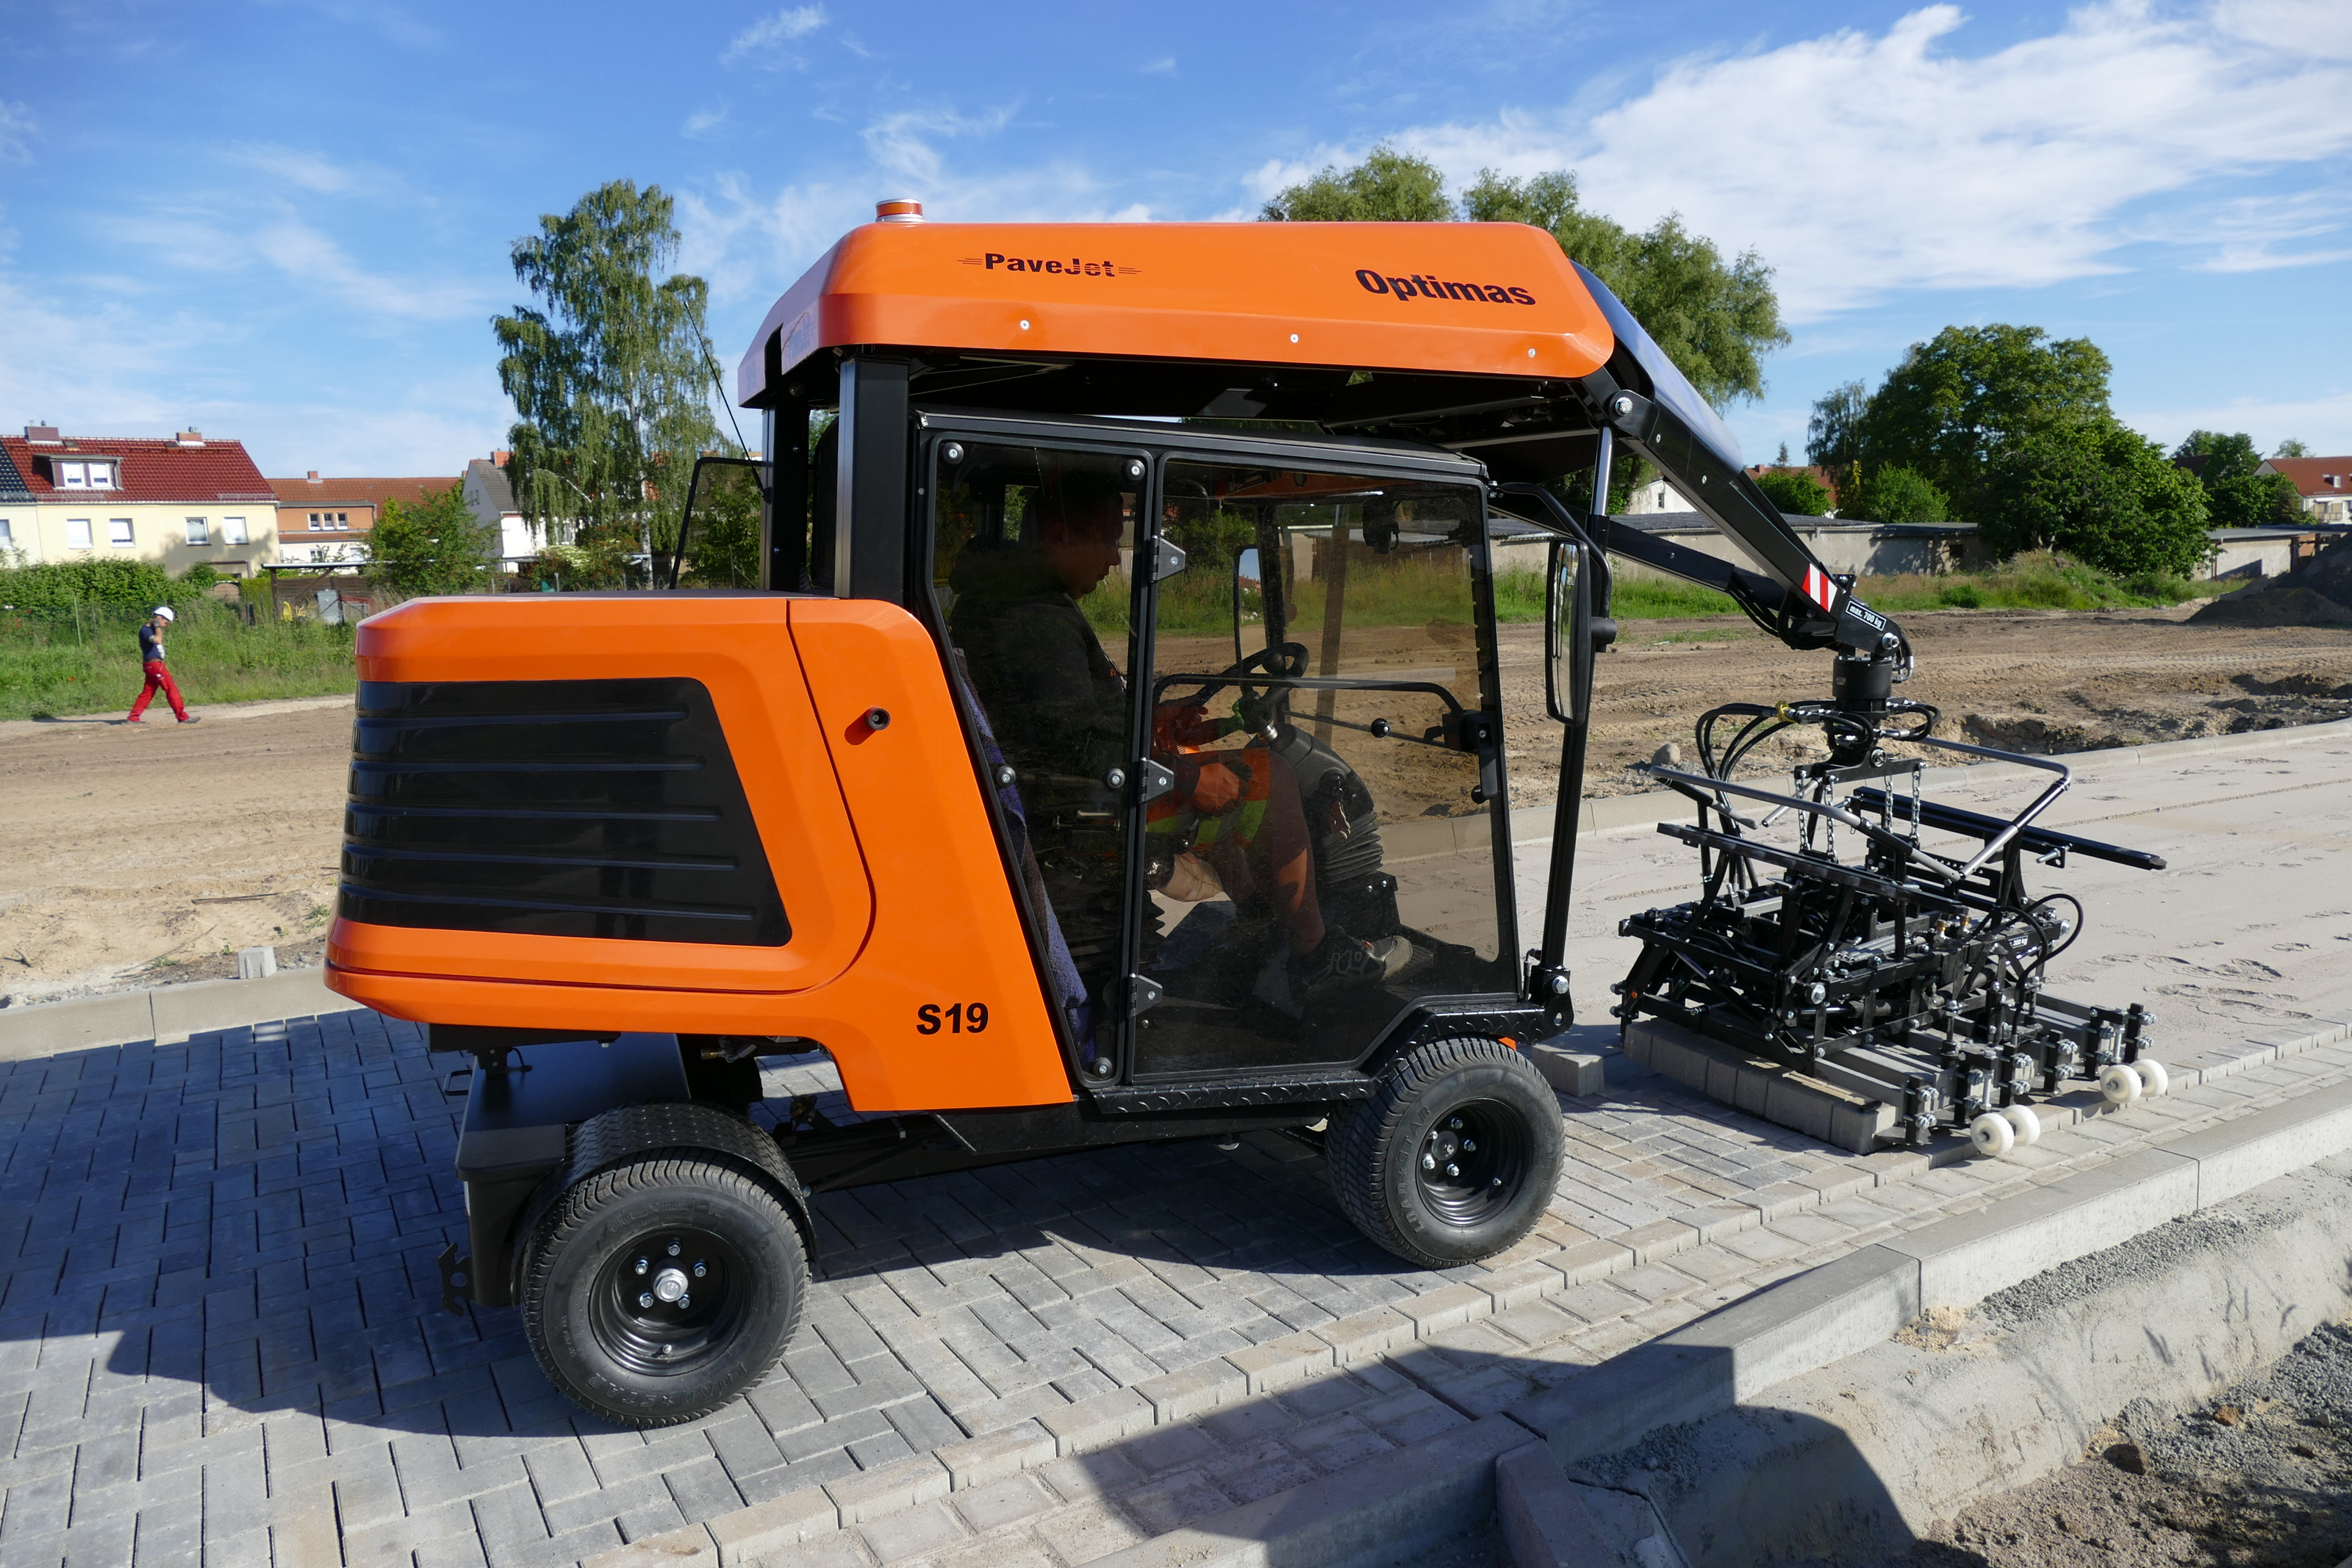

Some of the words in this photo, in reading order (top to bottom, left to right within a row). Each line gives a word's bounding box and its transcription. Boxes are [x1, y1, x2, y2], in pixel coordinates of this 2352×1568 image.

[985, 253, 1116, 277] PaveJet
[1355, 269, 1536, 306] Optimas
[1849, 606, 1862, 616] max.
[1864, 612, 1875, 622] 700
[1874, 617, 1882, 628] kg
[916, 1002, 989, 1035] S19
[1398, 1105, 1431, 1163] STAR
[1397, 1182, 1425, 1234] LOAD
